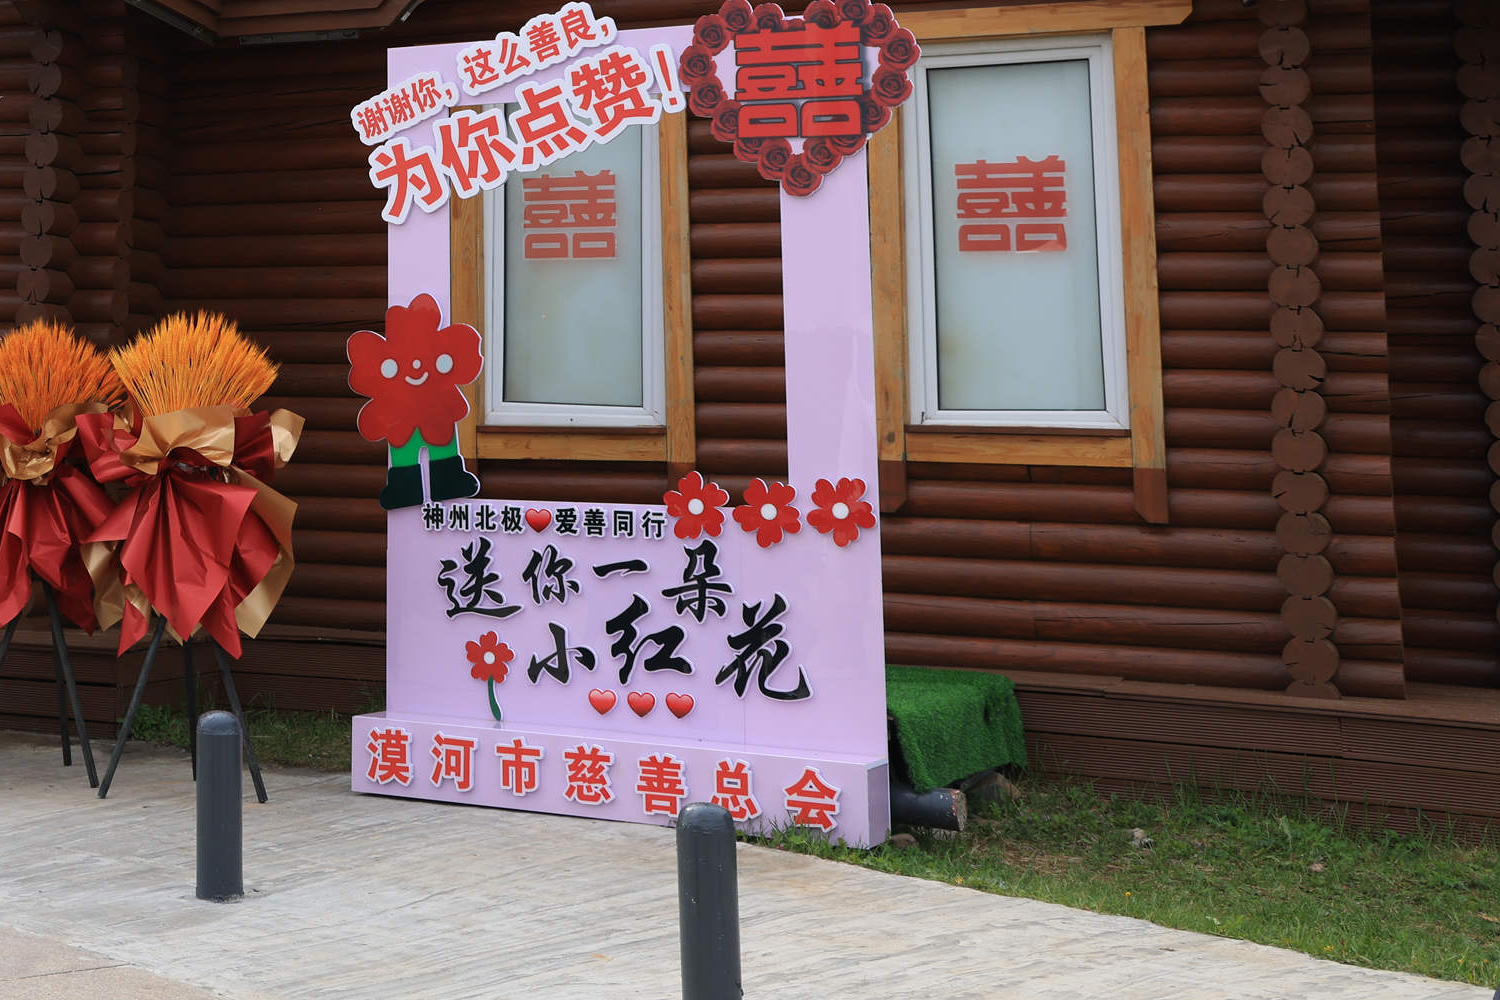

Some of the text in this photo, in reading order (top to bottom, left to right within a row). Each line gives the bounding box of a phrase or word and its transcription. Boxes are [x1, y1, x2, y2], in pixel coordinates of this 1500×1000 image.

[375, 50, 679, 218] 为你点赞！
[438, 537, 733, 622] 送你一朵
[527, 594, 812, 700] 小红花
[367, 728, 840, 830] 漠河市慈善总会
